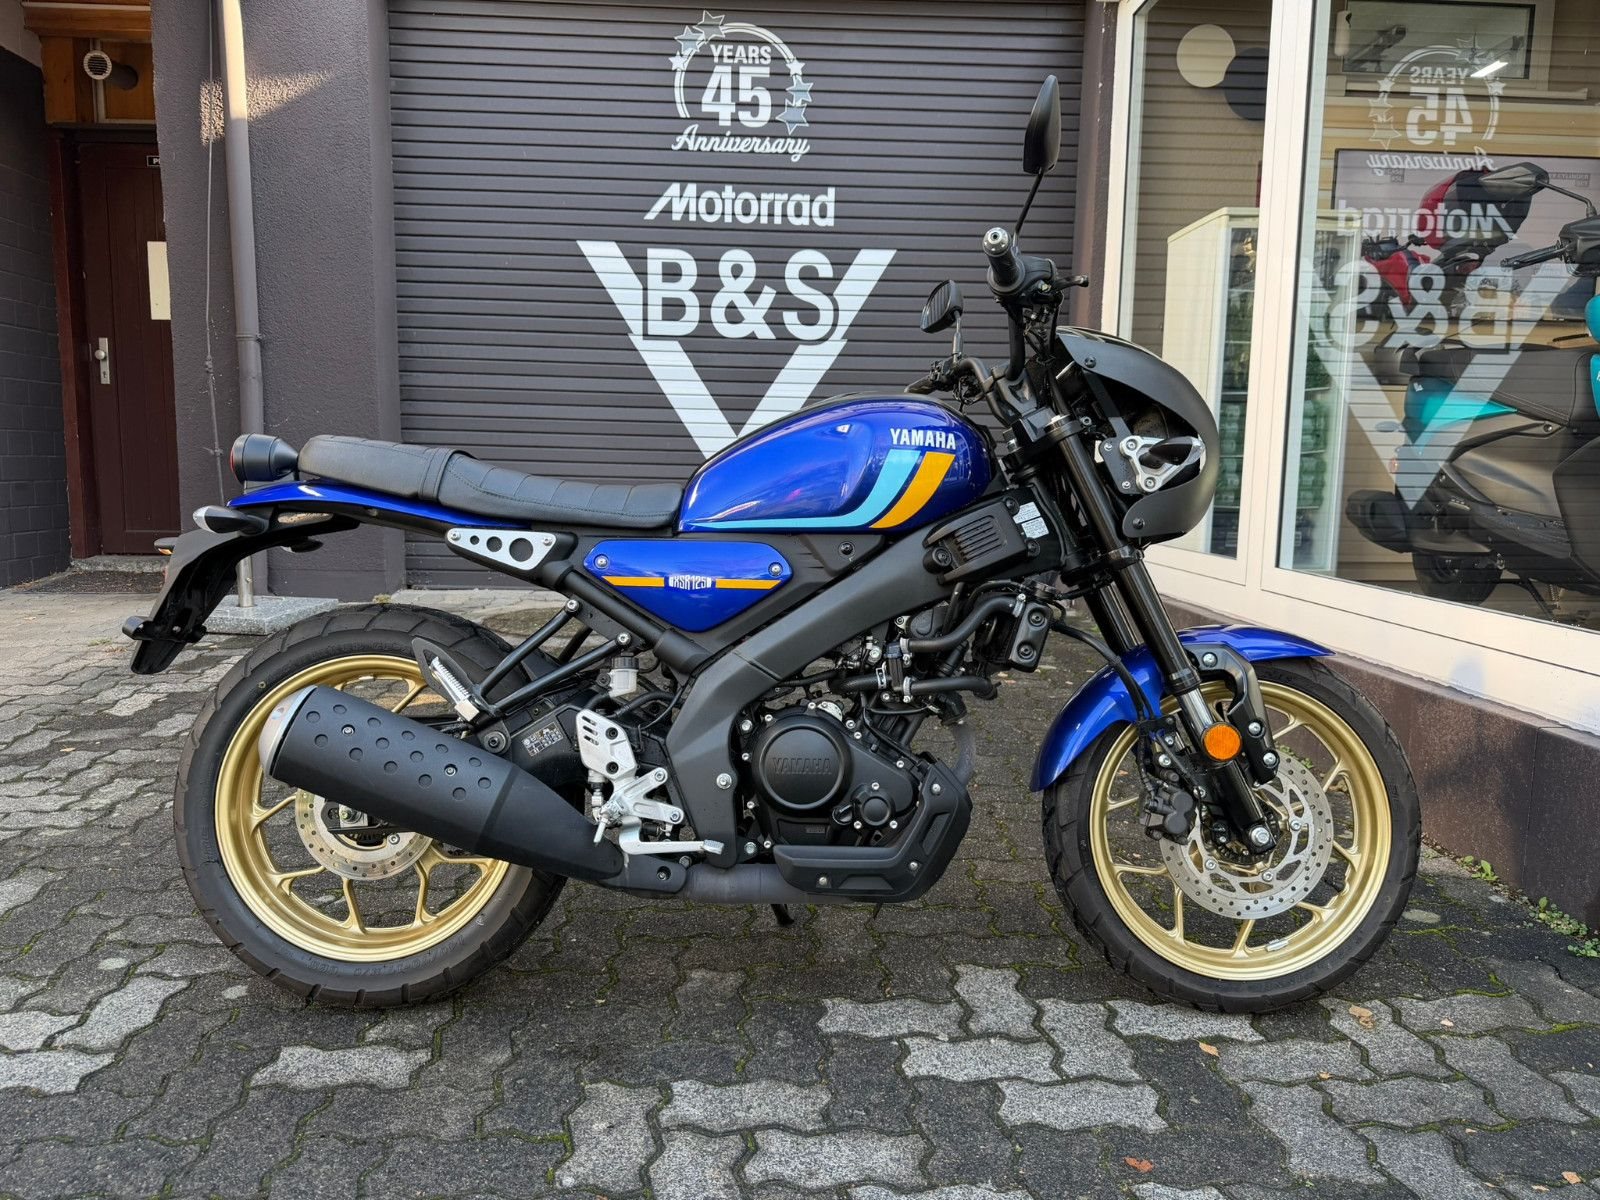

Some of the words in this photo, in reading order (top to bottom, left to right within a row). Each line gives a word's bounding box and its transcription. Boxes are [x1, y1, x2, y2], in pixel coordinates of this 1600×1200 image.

[710, 44, 771, 64] YEARS
[701, 65, 771, 127] 45
[671, 124, 811, 162] Anniversary
[643, 182, 835, 227] Motorrad
[646, 247, 835, 341] B&S
[889, 427, 957, 450] YAMAHA
[772, 756, 833, 775] YAMAHA
